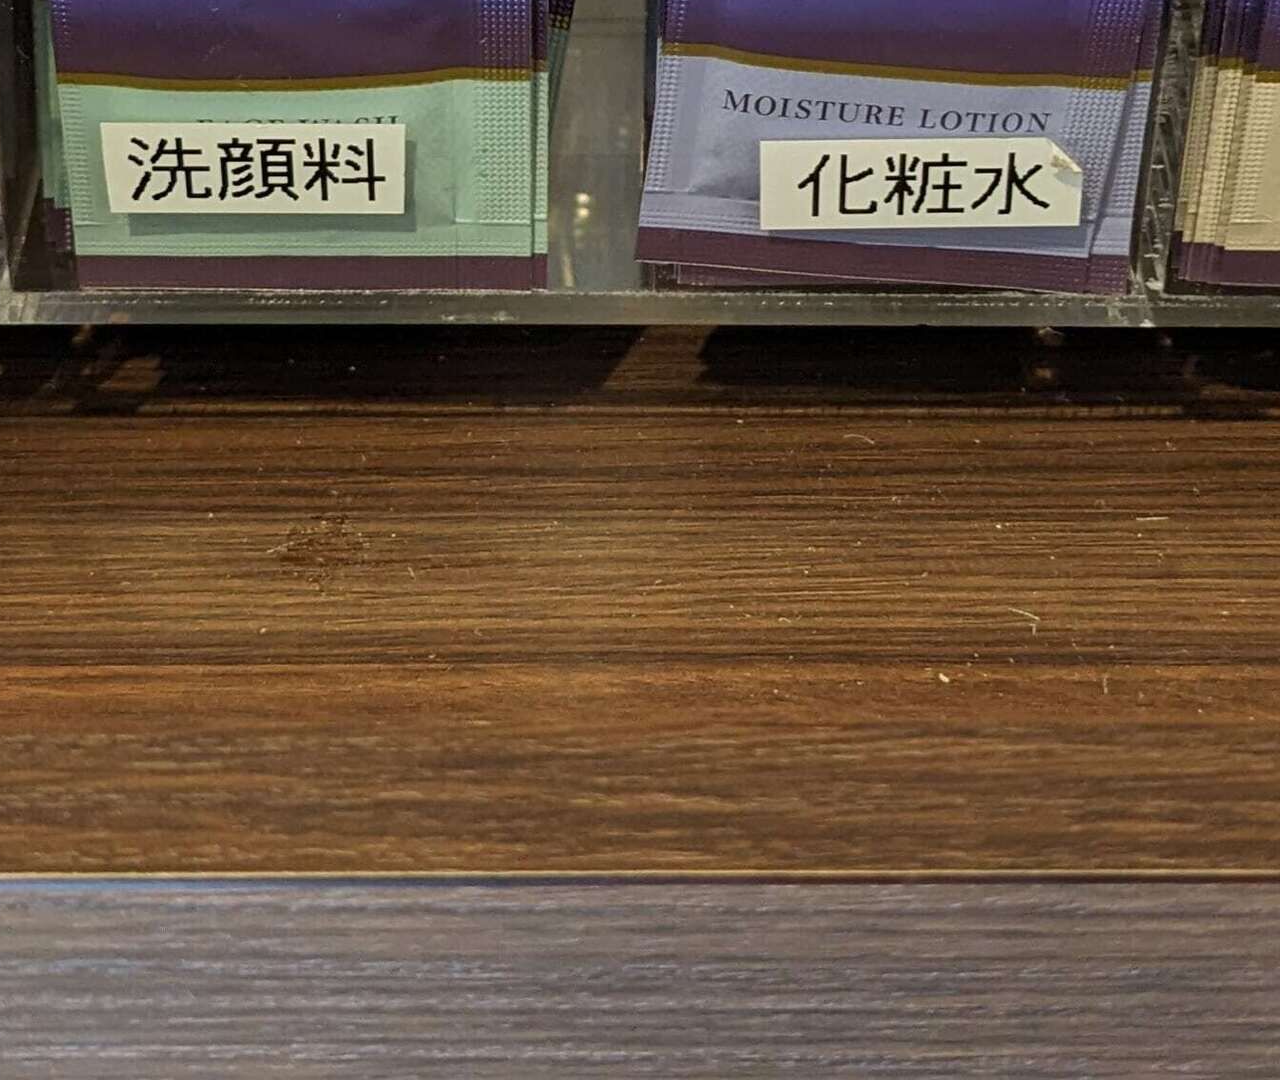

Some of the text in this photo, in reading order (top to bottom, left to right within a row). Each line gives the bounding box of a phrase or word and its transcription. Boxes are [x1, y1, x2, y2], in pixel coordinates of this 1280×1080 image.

[721, 89, 1053, 134] MOISTURE LOTION
[128, 138, 385, 200] 洗顔料
[799, 153, 1049, 216] 化粧水
